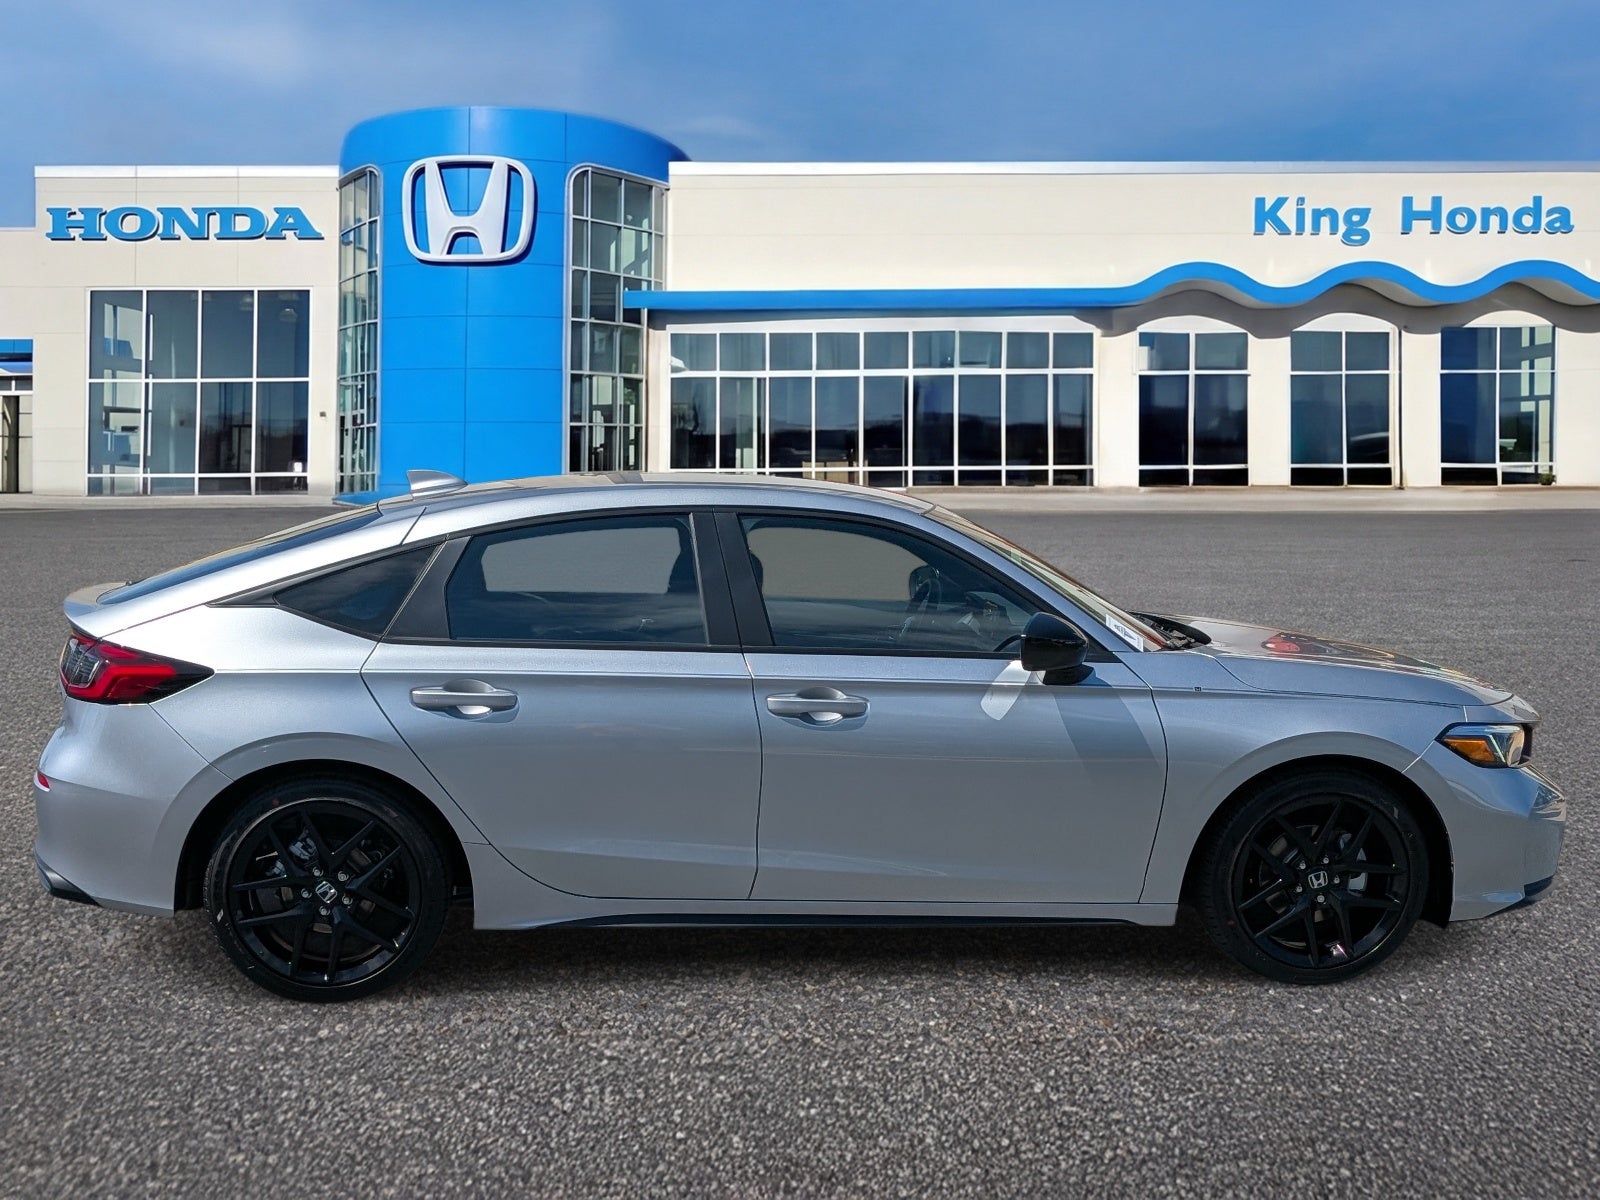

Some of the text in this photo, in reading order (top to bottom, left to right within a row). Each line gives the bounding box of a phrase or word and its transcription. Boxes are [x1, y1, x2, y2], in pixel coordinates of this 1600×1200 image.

[45, 206, 324, 241] HONDA
[1253, 195, 1575, 246] King Honda
